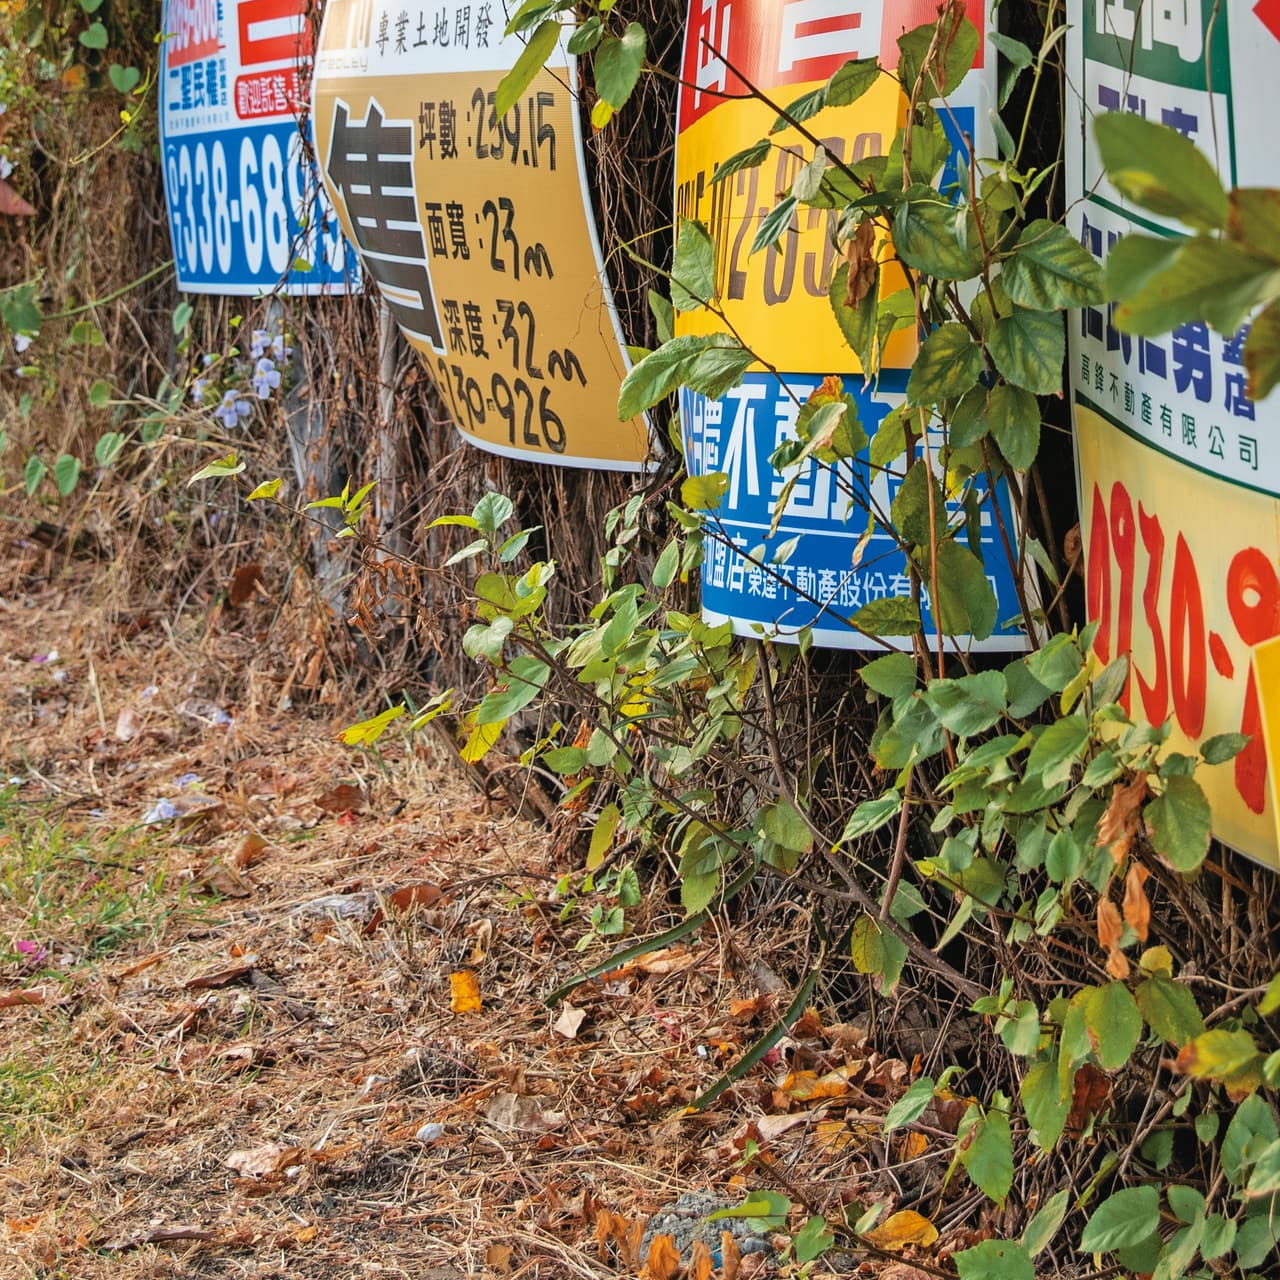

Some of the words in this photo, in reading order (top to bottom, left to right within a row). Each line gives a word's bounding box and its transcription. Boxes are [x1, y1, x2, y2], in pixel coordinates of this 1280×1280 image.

[376, 1, 536, 56] 專業土地開發
[326, 97, 447, 354] 售
